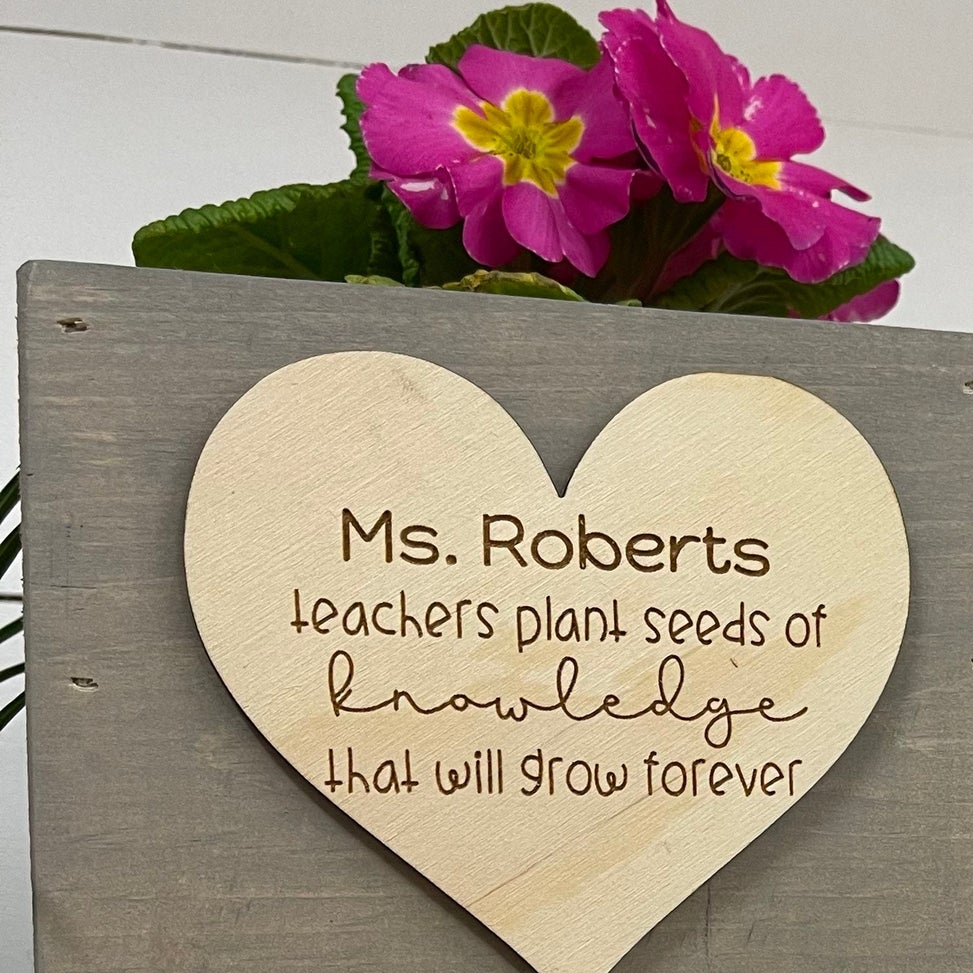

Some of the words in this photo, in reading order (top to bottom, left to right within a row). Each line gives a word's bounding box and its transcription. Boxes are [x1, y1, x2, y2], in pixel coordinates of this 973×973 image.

[341, 508, 458, 567] Ms.
[482, 512, 771, 577] Roberts
[290, 588, 500, 640] teachers
[517, 595, 627, 653] plant
[644, 600, 771, 648] seeds
[784, 603, 828, 648] of
[327, 650, 809, 748] knowledge
[324, 748, 419, 794] that
[435, 748, 504, 796] will
[520, 748, 628, 796] grow
[643, 750, 803, 797] forever
